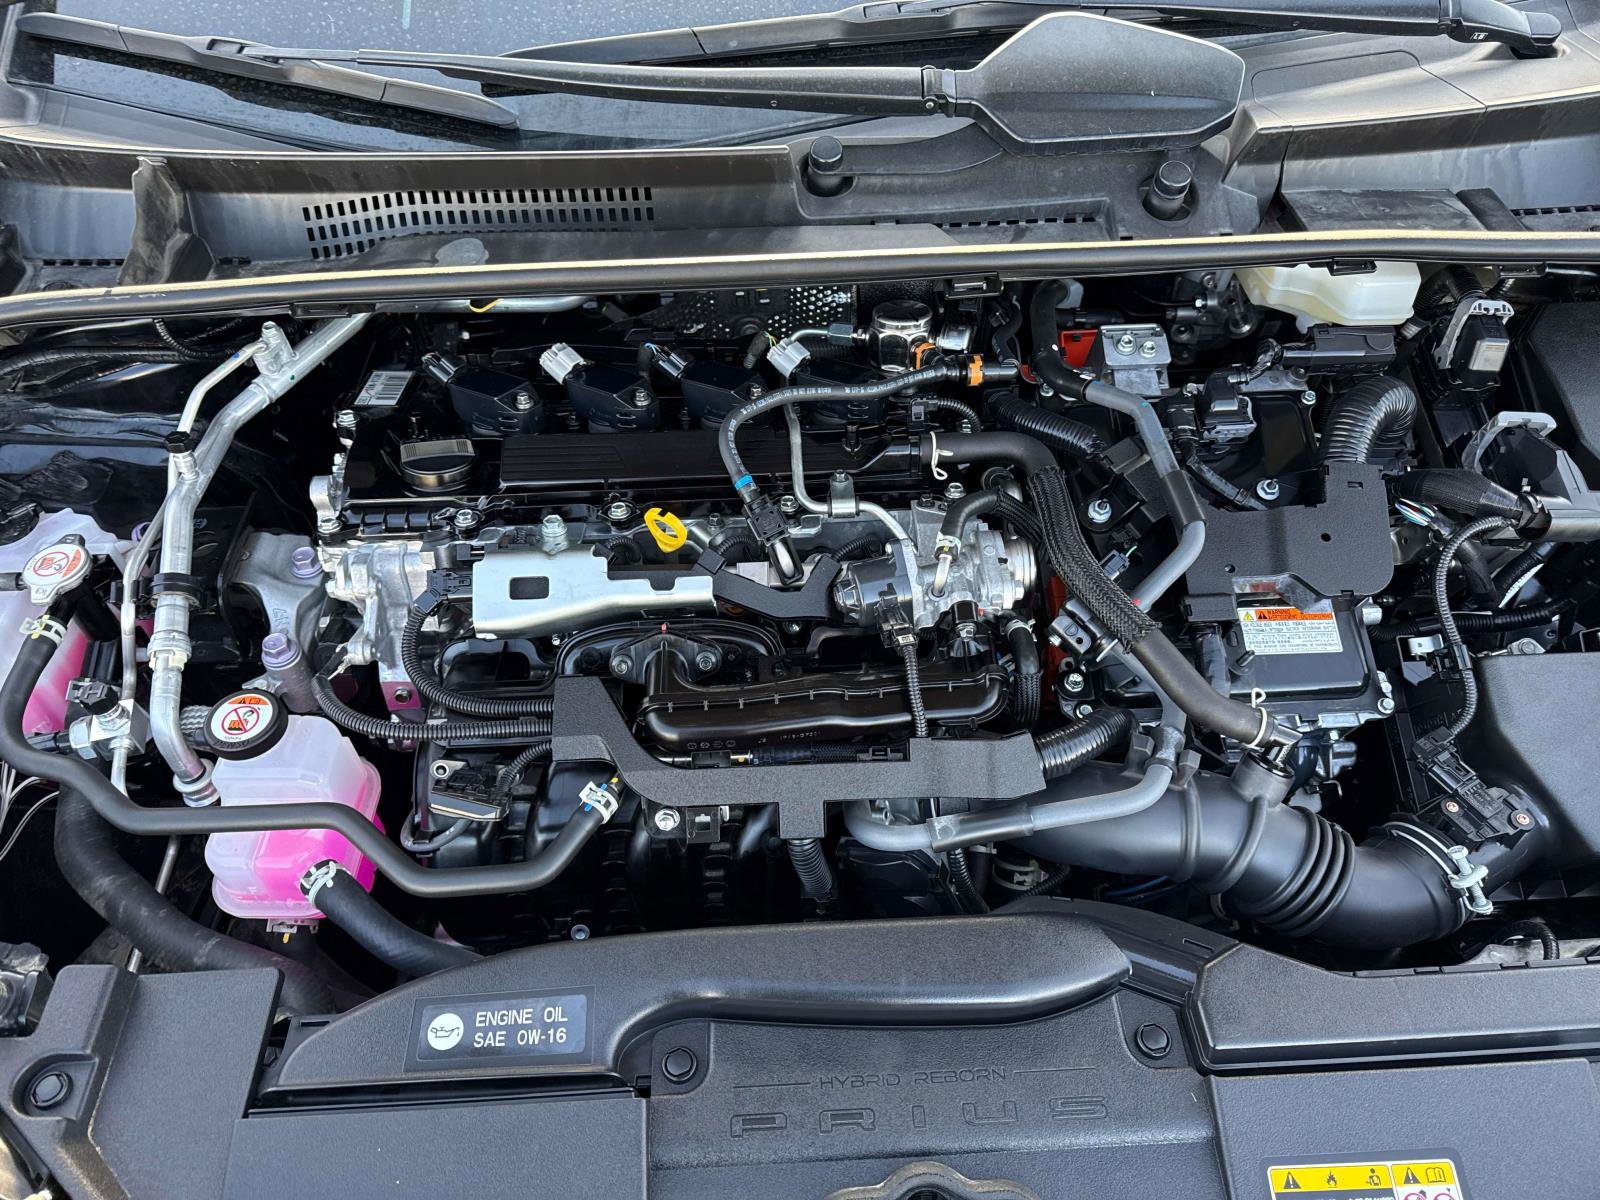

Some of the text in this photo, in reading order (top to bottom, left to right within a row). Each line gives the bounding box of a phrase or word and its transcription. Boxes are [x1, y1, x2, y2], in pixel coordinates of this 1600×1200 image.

[475, 1006, 568, 1027] ENGINE OIL
[473, 1031, 506, 1048] SAE
[819, 1068, 1007, 1090] HYBRID REBORN
[730, 1096, 1108, 1139] PRIUS
